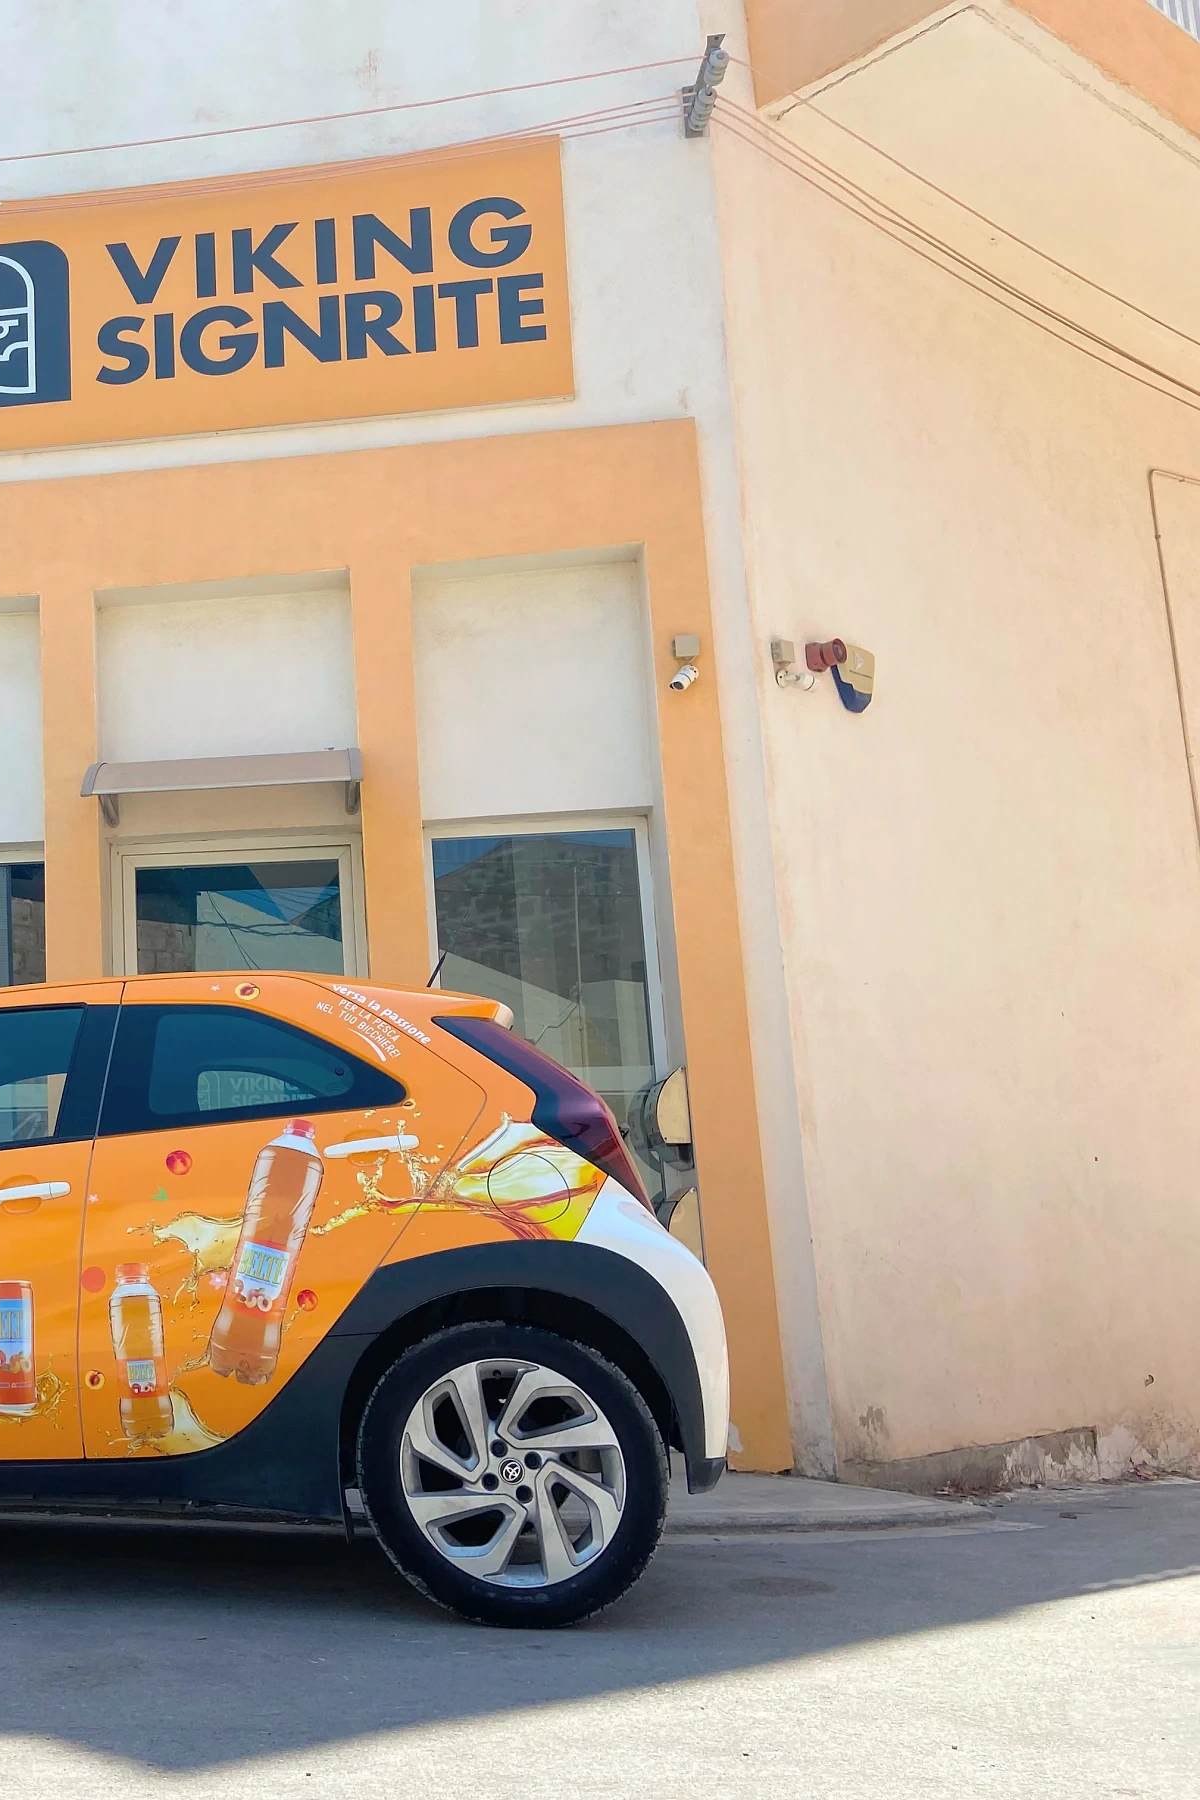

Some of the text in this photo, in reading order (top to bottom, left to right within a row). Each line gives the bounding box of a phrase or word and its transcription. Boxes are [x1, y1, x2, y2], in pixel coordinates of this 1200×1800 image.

[105, 197, 532, 304] VIKING
[95, 272, 547, 385] SIGNRITE
[316, 1001, 402, 1058] NEL TUO BICCHIERE!
[332, 984, 432, 1044] versa la passione
[339, 999, 400, 1042] PER LA PESCA
